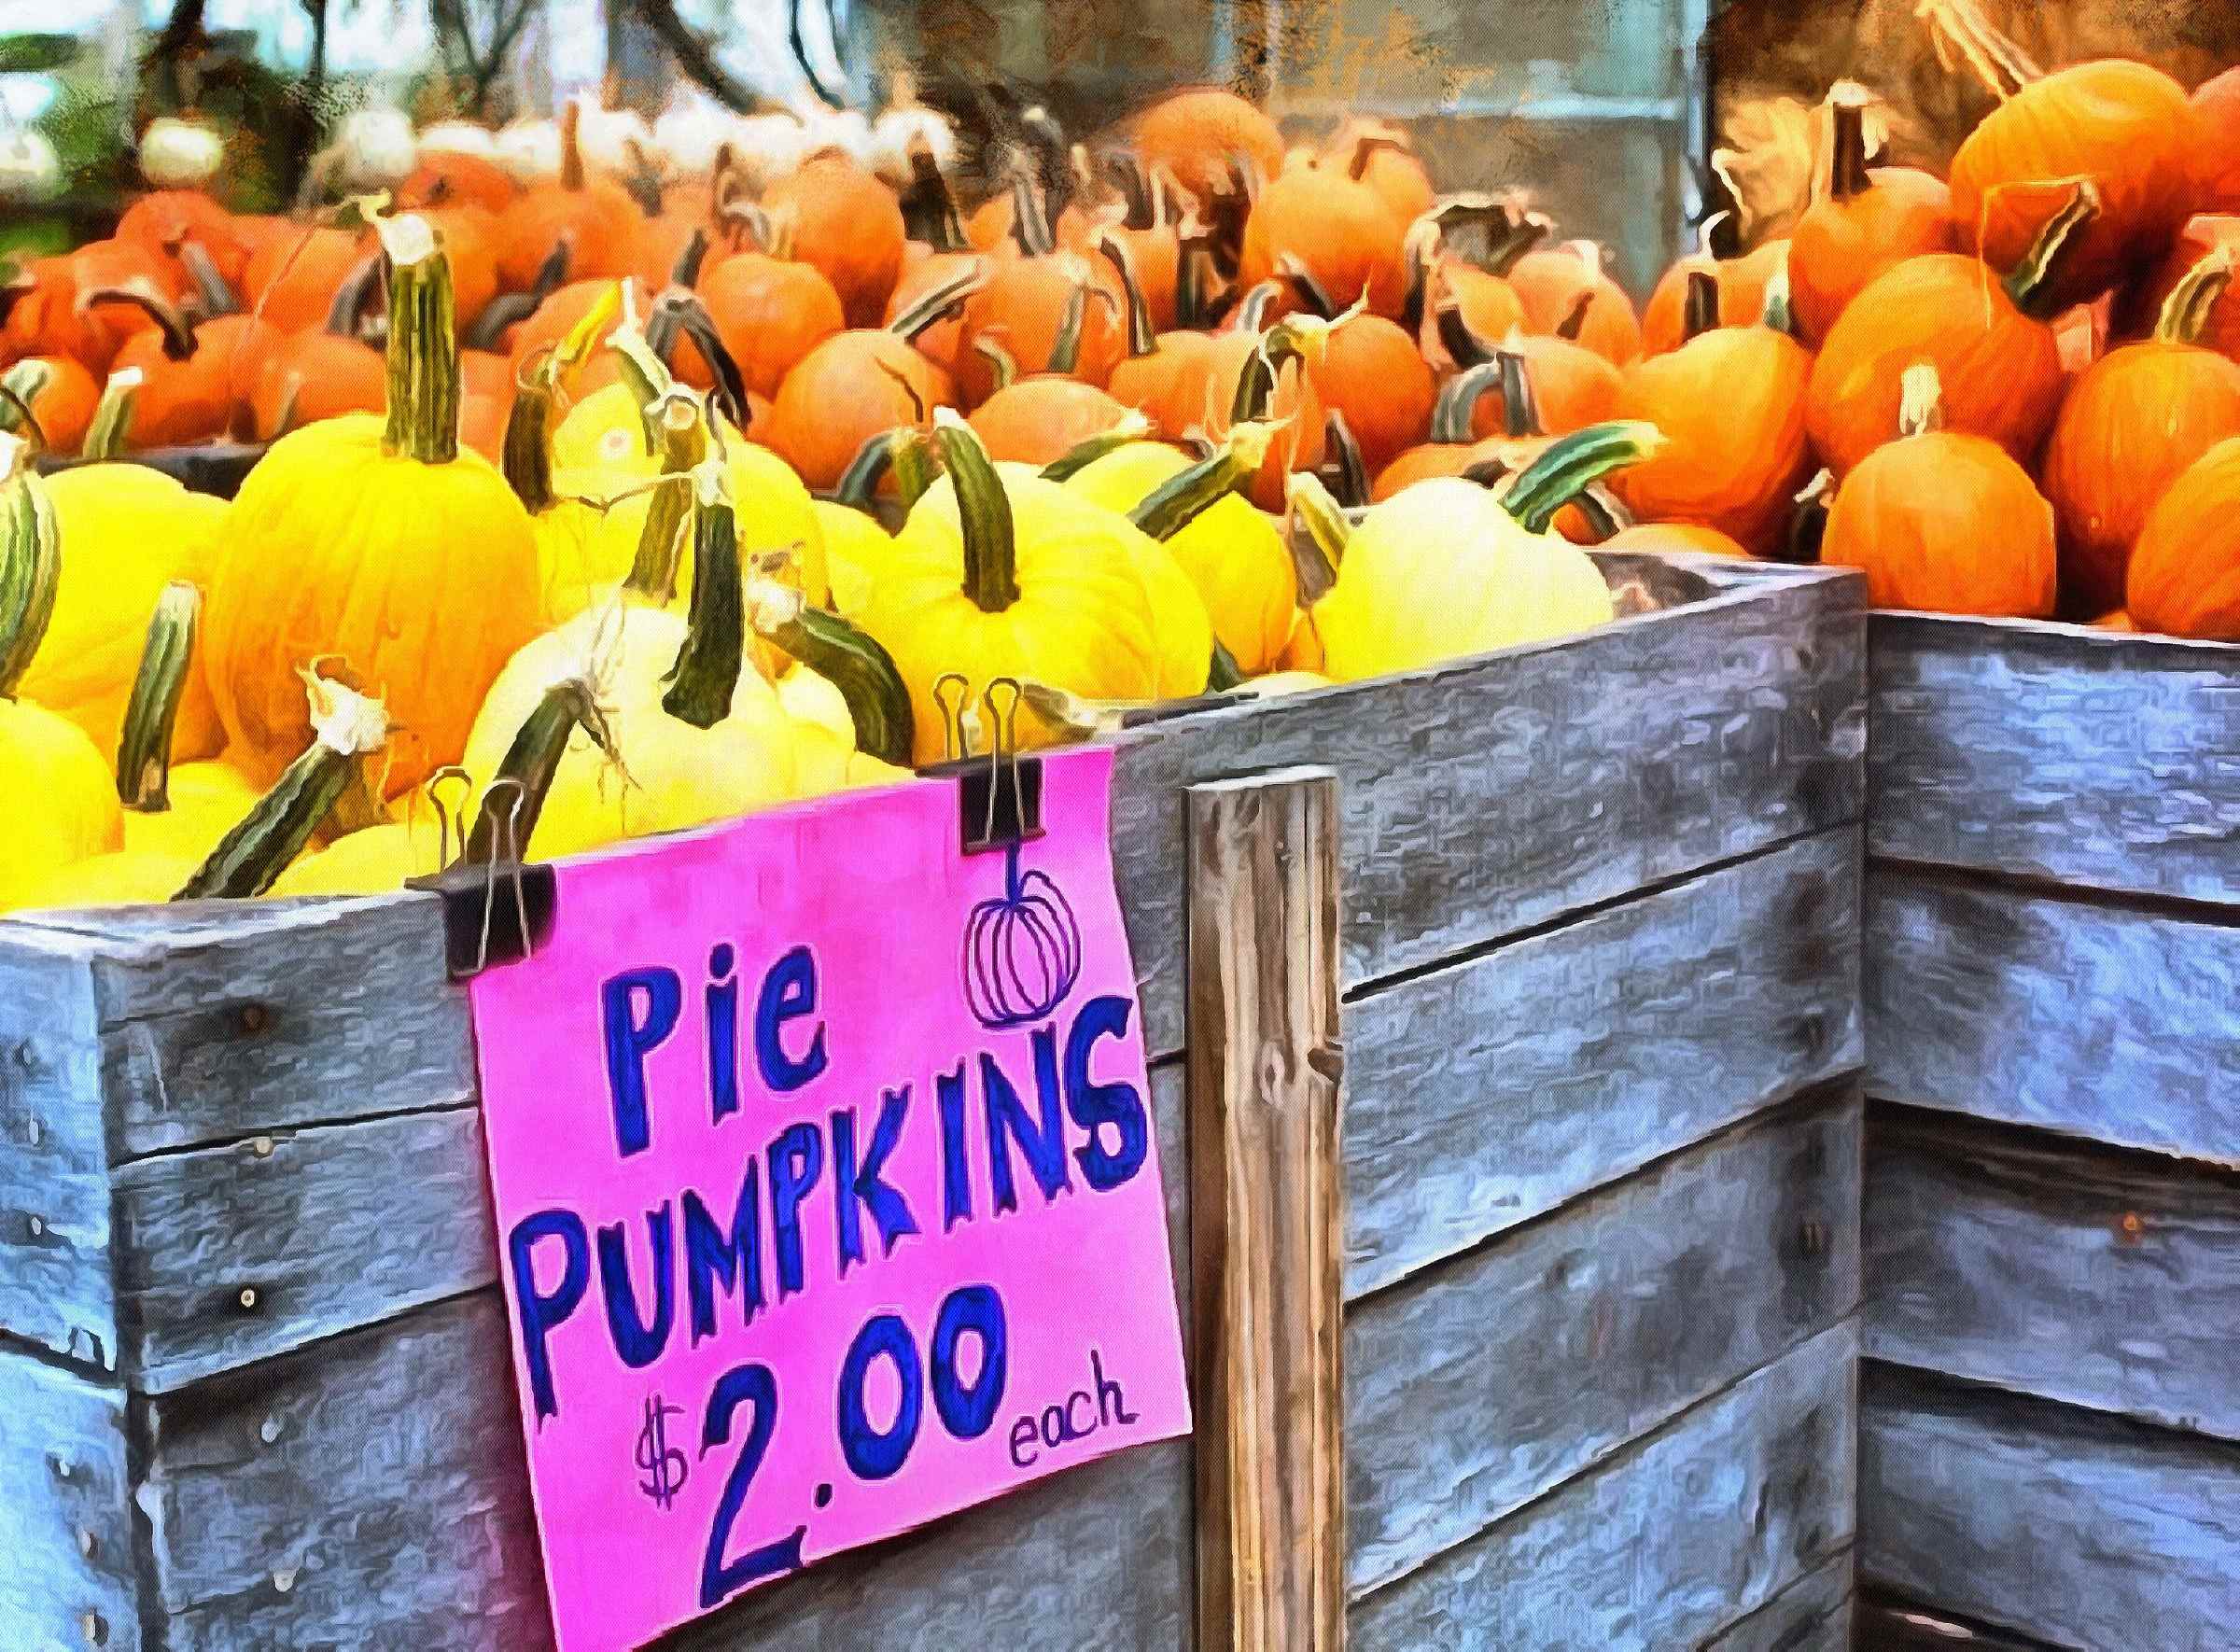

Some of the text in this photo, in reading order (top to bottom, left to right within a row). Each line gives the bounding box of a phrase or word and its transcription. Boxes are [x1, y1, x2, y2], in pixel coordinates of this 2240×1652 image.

[601, 944, 828, 1157] Pie
[508, 995, 1148, 1428] PUMPKINS
[1010, 1350, 1140, 1467] each
